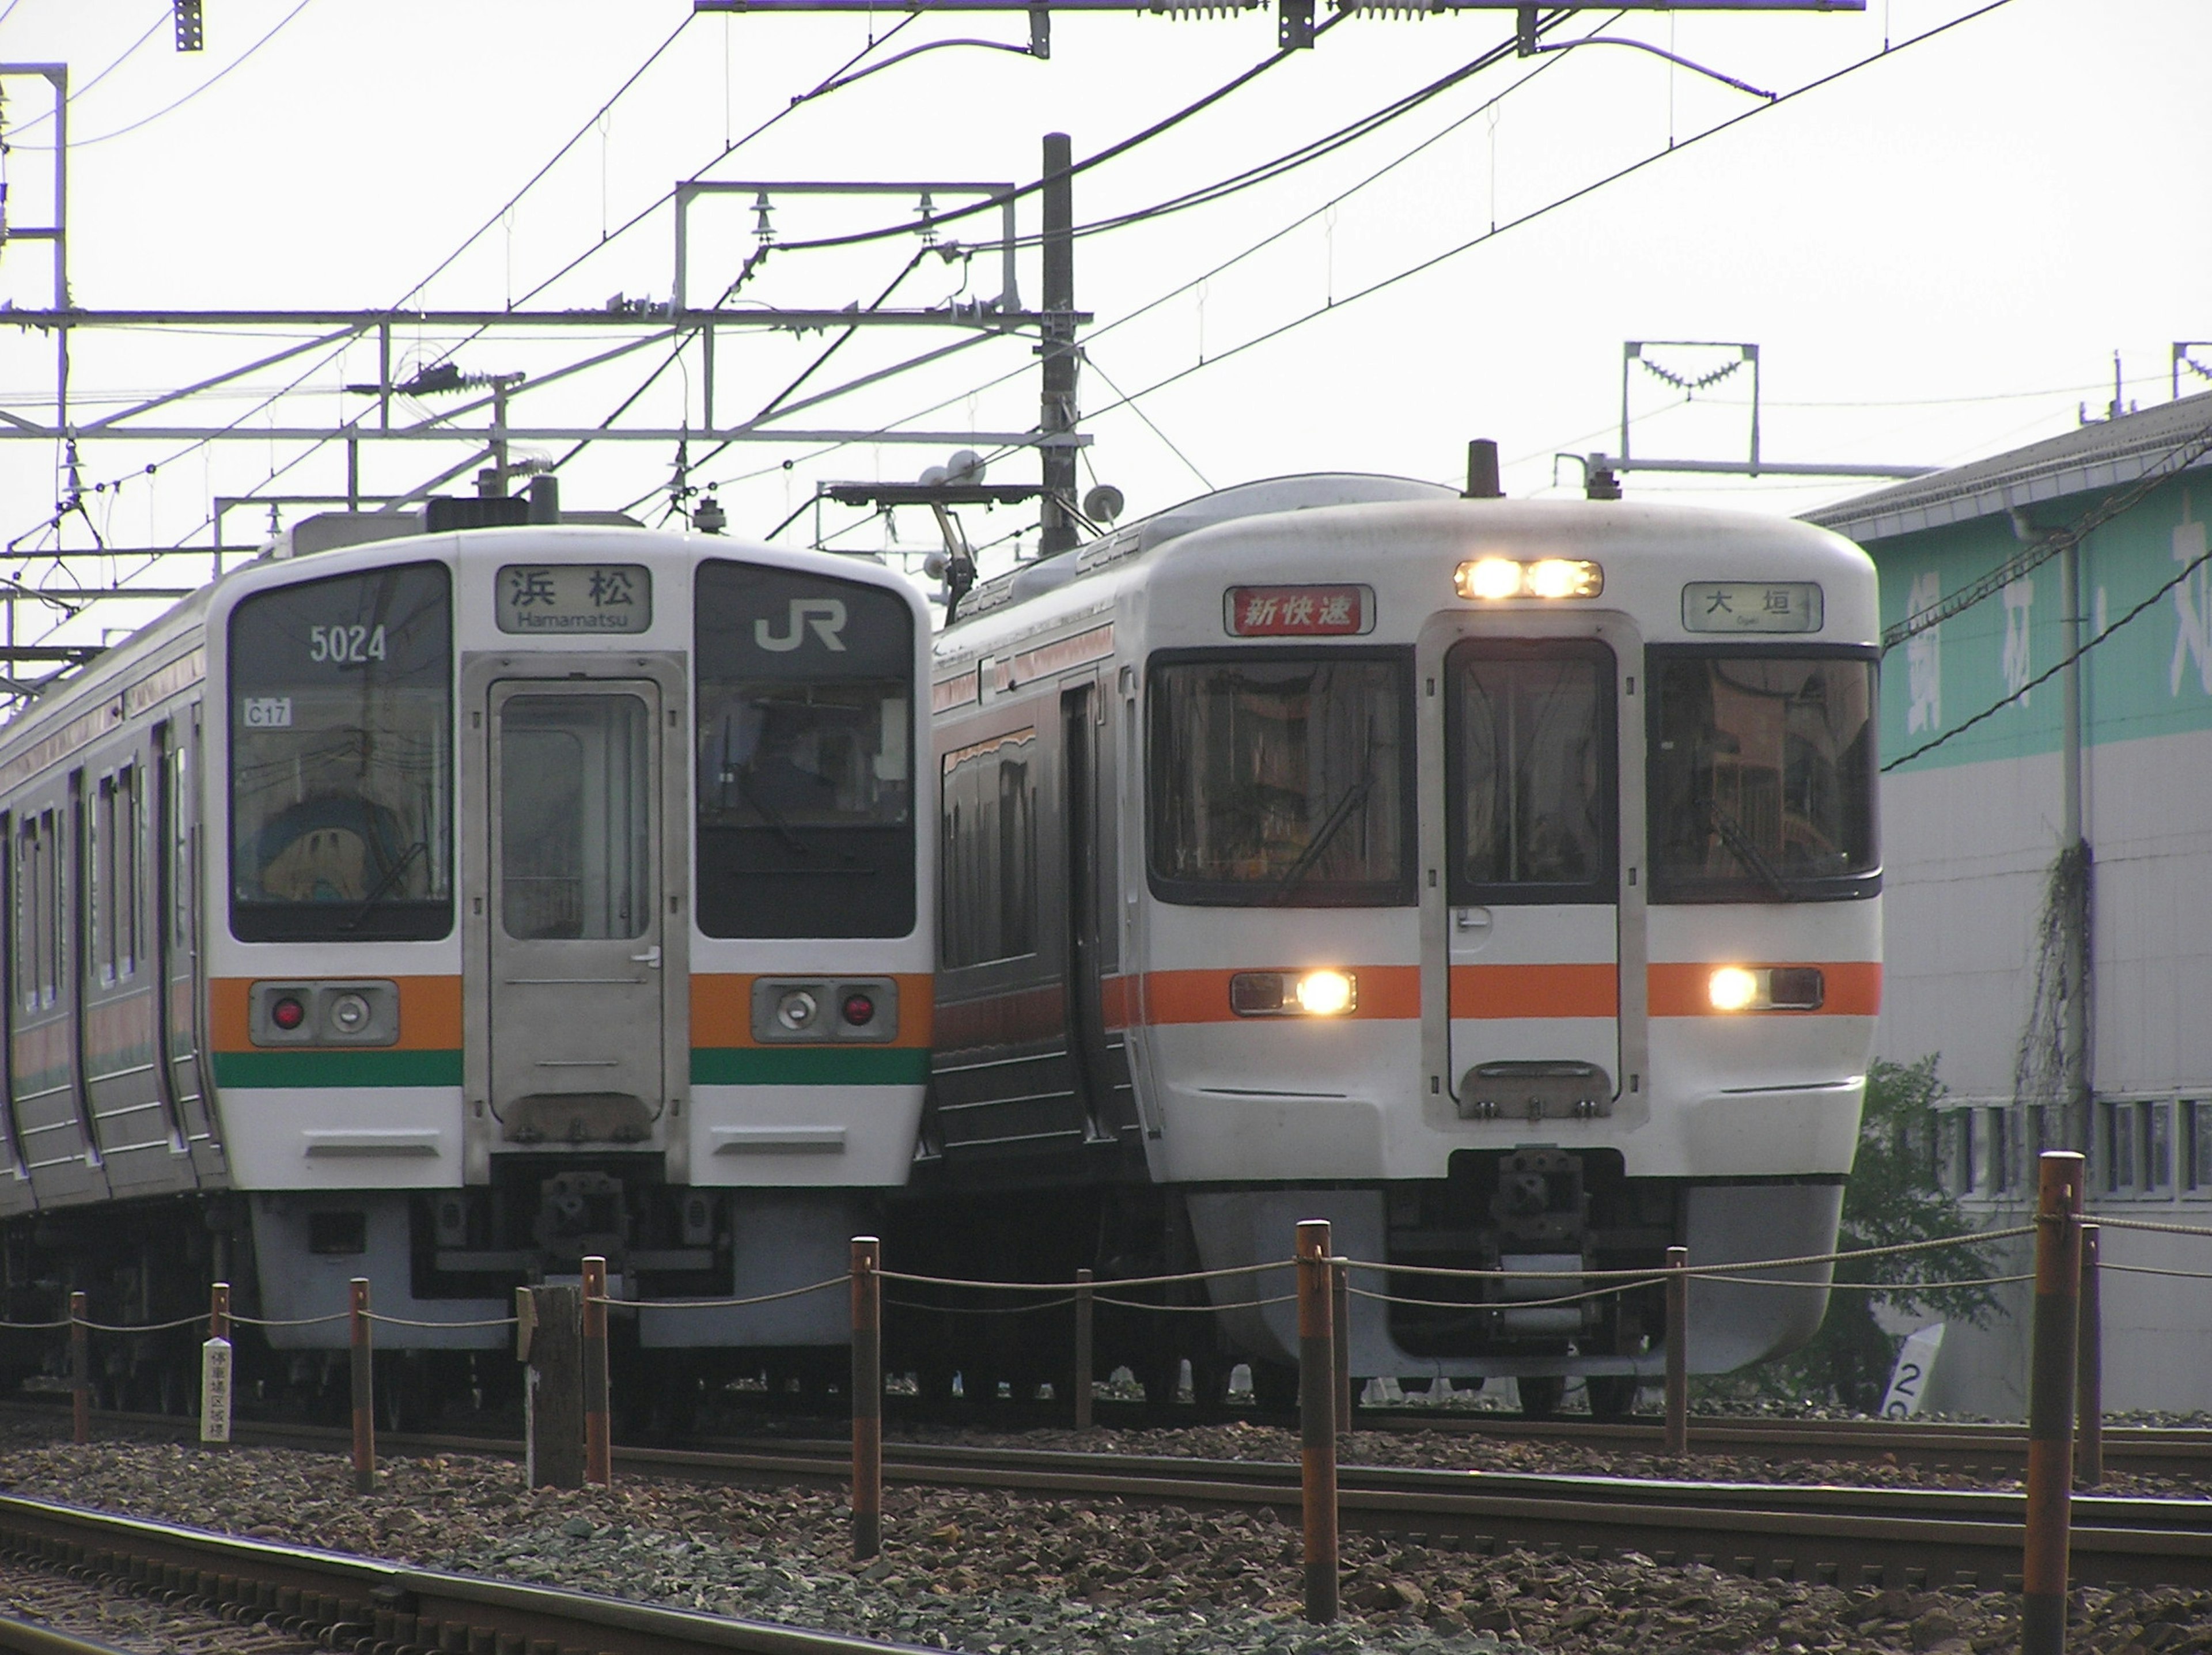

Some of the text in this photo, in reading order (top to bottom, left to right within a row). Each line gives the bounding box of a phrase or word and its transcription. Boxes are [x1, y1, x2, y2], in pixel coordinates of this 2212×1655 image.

[511, 570, 633, 607] 浜松
[1706, 590, 1790, 615] 大垣
[518, 612, 628, 627] Hamamatsu
[754, 599, 847, 652] JR
[1244, 595, 1353, 626] 新快速
[310, 624, 387, 662] 5024
[249, 706, 286, 724] C17
